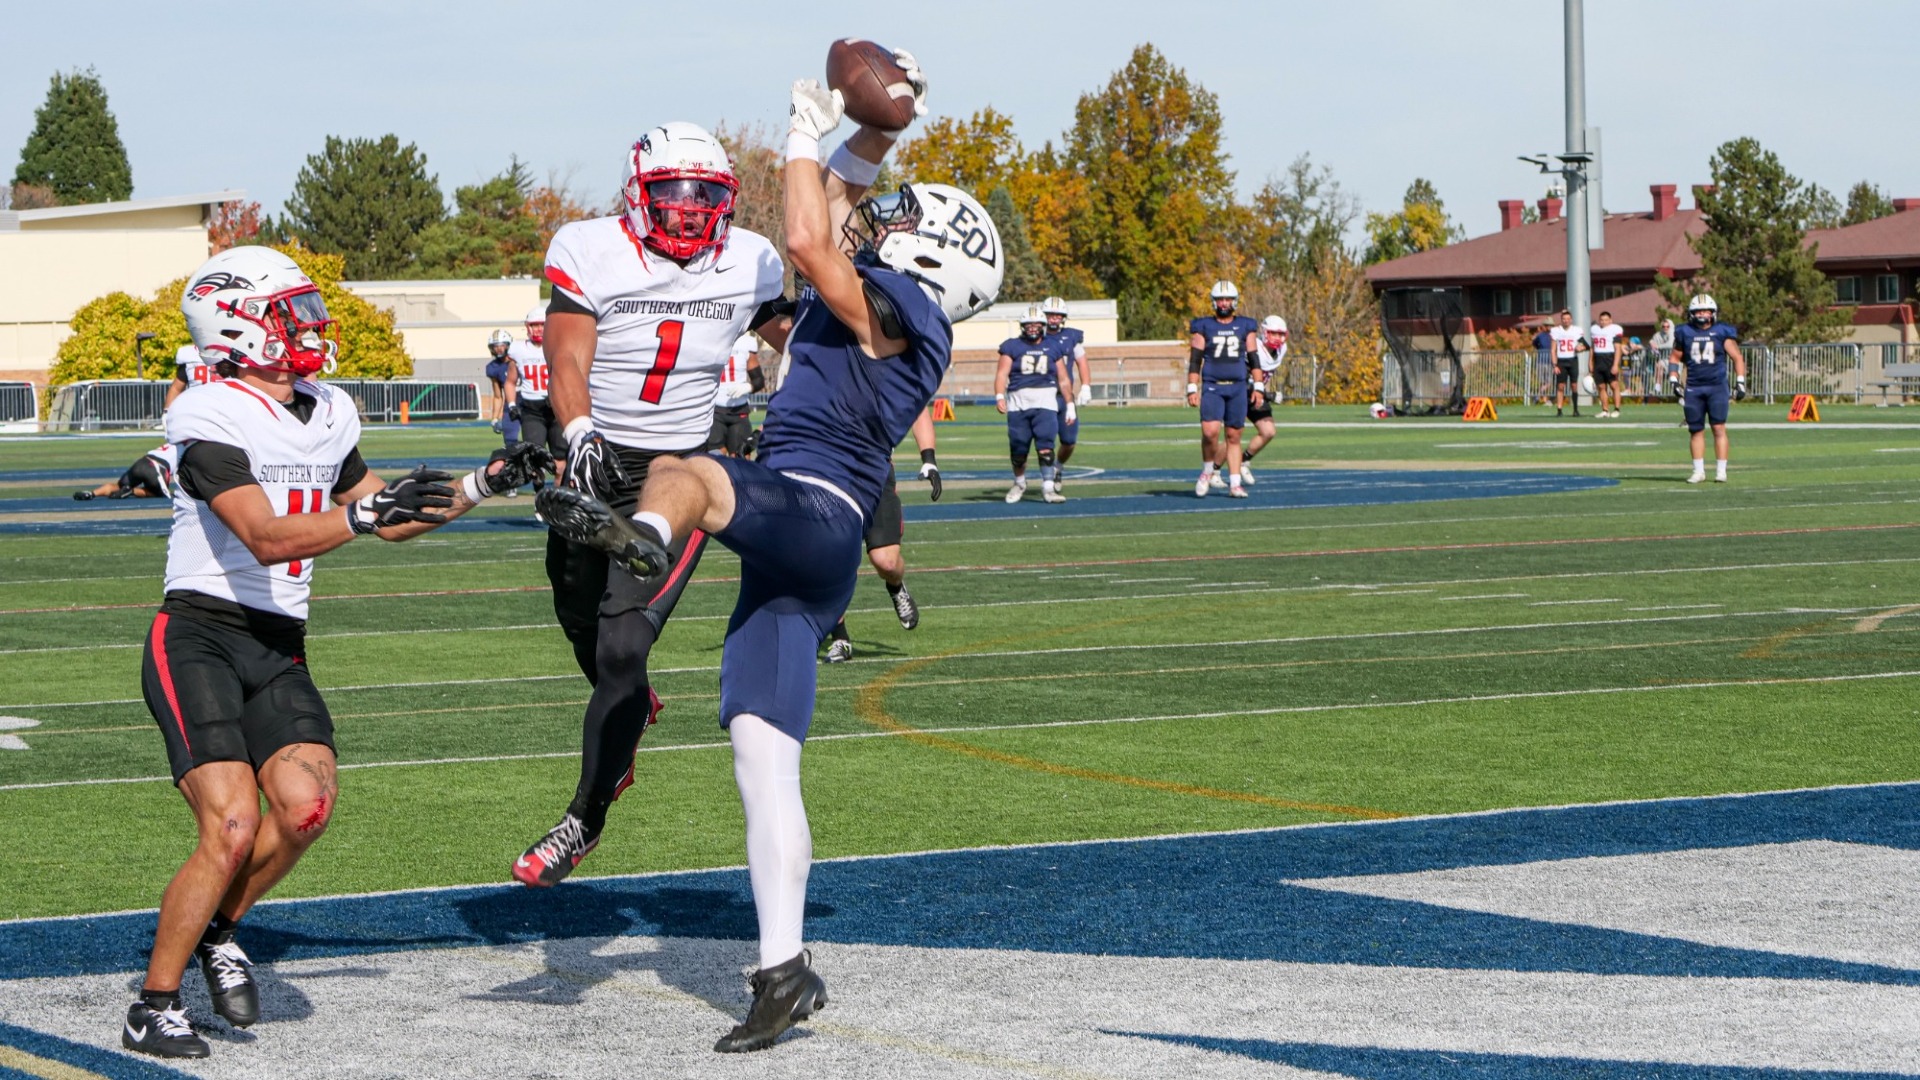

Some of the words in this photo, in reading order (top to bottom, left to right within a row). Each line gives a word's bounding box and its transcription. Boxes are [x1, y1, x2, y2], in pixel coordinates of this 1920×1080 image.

[946, 202, 988, 259] EO
[613, 299, 685, 315] SOUTHERN
[687, 300, 736, 321] OREGON
[1212, 335, 1240, 358] 72
[1558, 338, 1574, 352] 26
[1690, 341, 1715, 364] 44
[638, 318, 685, 406] 1
[1021, 354, 1048, 375] 64
[259, 464, 312, 483] SOUTHERN
